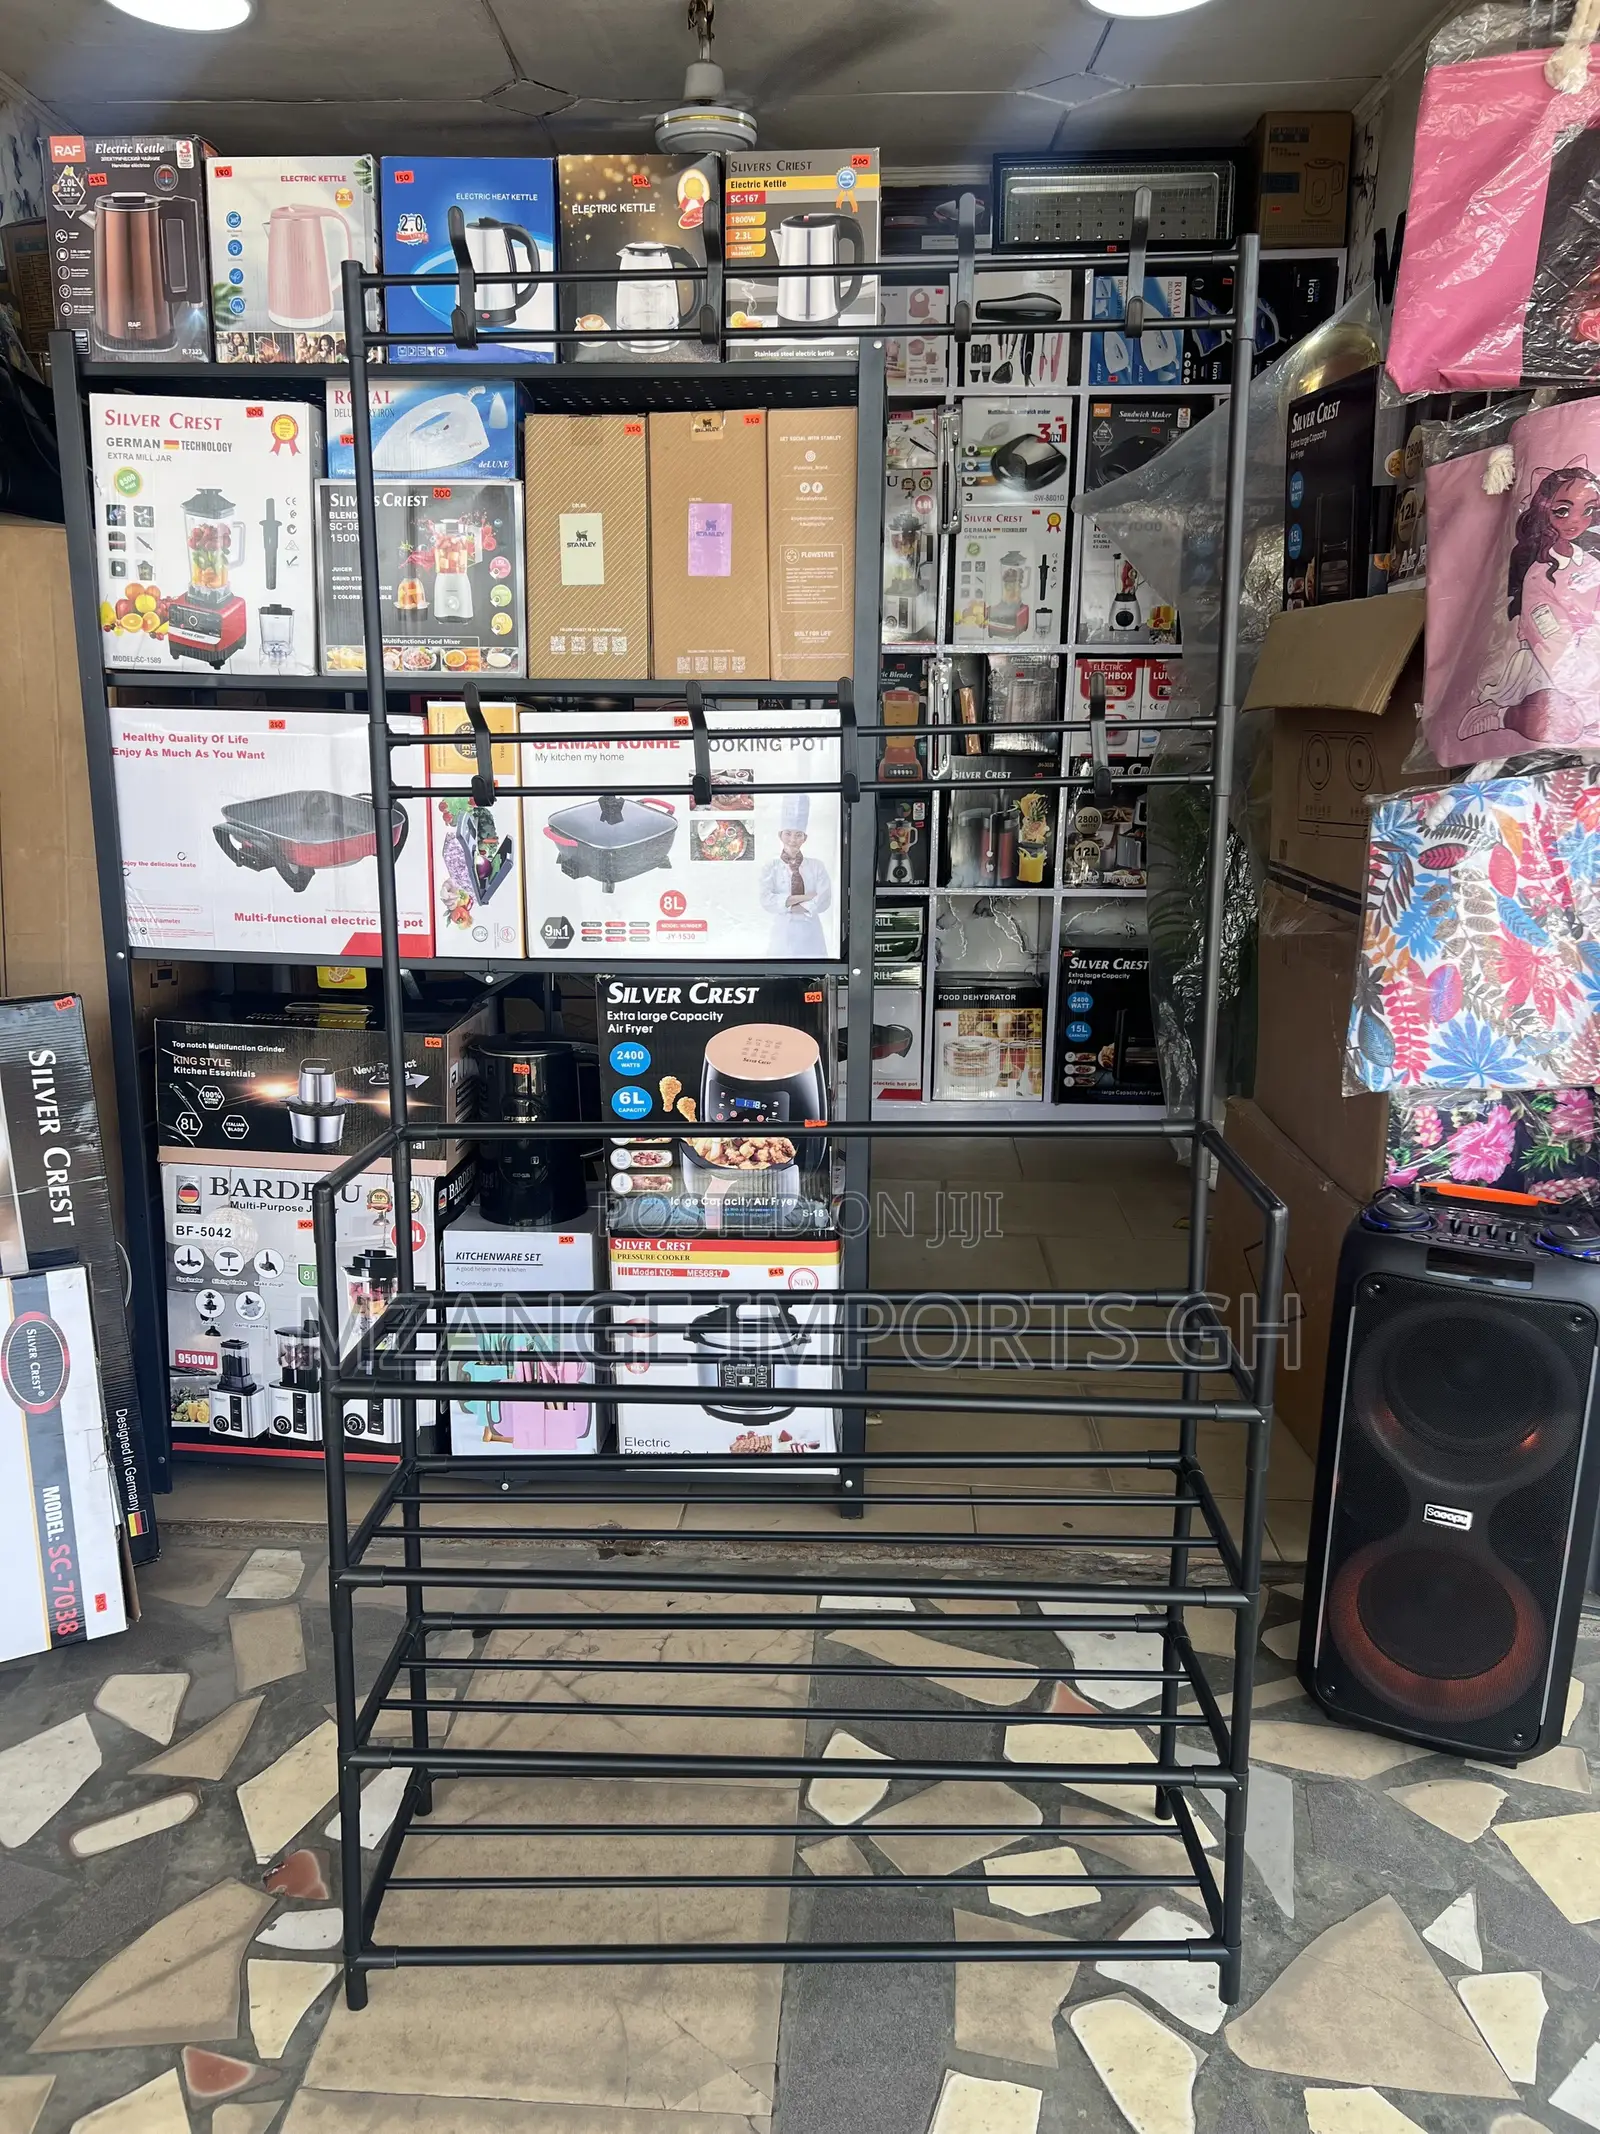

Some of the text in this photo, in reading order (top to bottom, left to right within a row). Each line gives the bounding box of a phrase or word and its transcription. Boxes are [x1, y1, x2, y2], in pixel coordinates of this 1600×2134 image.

[54, 145, 81, 156] RAF
[95, 143, 165, 154] Electric Kettle
[730, 160, 813, 173] SLIVERS CRIEST
[852, 158, 868, 166] 200
[280, 175, 347, 183] ELECTRIC KETTLE
[396, 174, 409, 182] 150
[730, 179, 787, 189] Electric Kettle
[456, 192, 491, 201] ELECTRIC
[511, 193, 538, 201] KETTLE
[730, 194, 759, 203] SC-167
[571, 203, 656, 215] ELECTRIC KETTLE
[400, 215, 423, 232] 2.0
[731, 216, 757, 224] 1800W
[735, 231, 752, 240] 2.3L
[1307, 278, 1317, 303] Iron
[1212, 361, 1221, 380] Iron
[1118, 410, 1150, 418] Sandwich
[1291, 401, 1341, 434] SILVER CREST
[105, 409, 223, 431] SILVER CREST
[1036, 423, 1067, 443] 3 IN 1
[106, 436, 232, 453] GERMAN TECHNOLOGY
[107, 452, 172, 462] EXTRA MILL JAR
[478, 459, 510, 469] deLUXE
[965, 493, 973, 501] 3
[963, 513, 1023, 523] SILVER CREST
[1290, 531, 1301, 542] 15L
[567, 541, 597, 549] STANLEY
[382, 637, 426, 645] Multifunctional
[889, 671, 914, 679] Blender
[122, 732, 249, 745] Healthy Quality Of Life
[112, 747, 265, 760] Enjoy As Much As You Want
[535, 751, 625, 764] My kitchen my home
[951, 769, 1012, 779] SILVER CREST
[1077, 815, 1099, 823] 2800
[1075, 847, 1099, 857] 12L
[663, 896, 684, 912] 8L
[234, 912, 327, 926] Multi-functional
[330, 915, 377, 927] electric
[403, 918, 423, 929] pot
[1068, 957, 1150, 970] SILVER CREST
[1101, 972, 1131, 980] Capacity
[607, 982, 760, 1005] SILVER CREST
[806, 994, 820, 1002] 500
[938, 993, 1017, 1001] FOOD DEHYDRATOR
[607, 1010, 724, 1024] Extra large Capacity
[607, 1023, 654, 1035] Air Fryer
[1070, 1024, 1088, 1033] 15L
[172, 1040, 285, 1054] Top notch Multifunction Grinder
[616, 1050, 645, 1061] 2400
[173, 1056, 231, 1067] KING STYLE
[173, 1066, 256, 1078] Kitchen Essentials
[201, 1091, 222, 1099] 100%
[619, 1092, 645, 1105] 6L
[180, 1118, 199, 1131] 8L
[28, 1049, 76, 1227] SILVER CREST
[229, 1200, 304, 1214] Multi-Purpose
[700, 1196, 752, 1209] Capacity
[753, 1197, 769, 1206] Air
[771, 1196, 798, 1208] Fryer
[802, 1208, 825, 1218] S-18
[175, 1224, 232, 1239] BF-5042
[614, 1238, 693, 1251] SILVER CREST
[455, 1251, 542, 1262] KITCHENWARE SET
[617, 1252, 691, 1261] PRESSURE COOKER
[474, 1266, 492, 1274] helper
[632, 1267, 724, 1278] Model NO: MES6817
[793, 1276, 815, 1287] NEW
[177, 1353, 215, 1366] 9500W
[624, 1436, 671, 1448] Electric
[115, 1408, 140, 1513] Designed In Germany
[42, 1484, 79, 1637] MODEL: SC-7038
